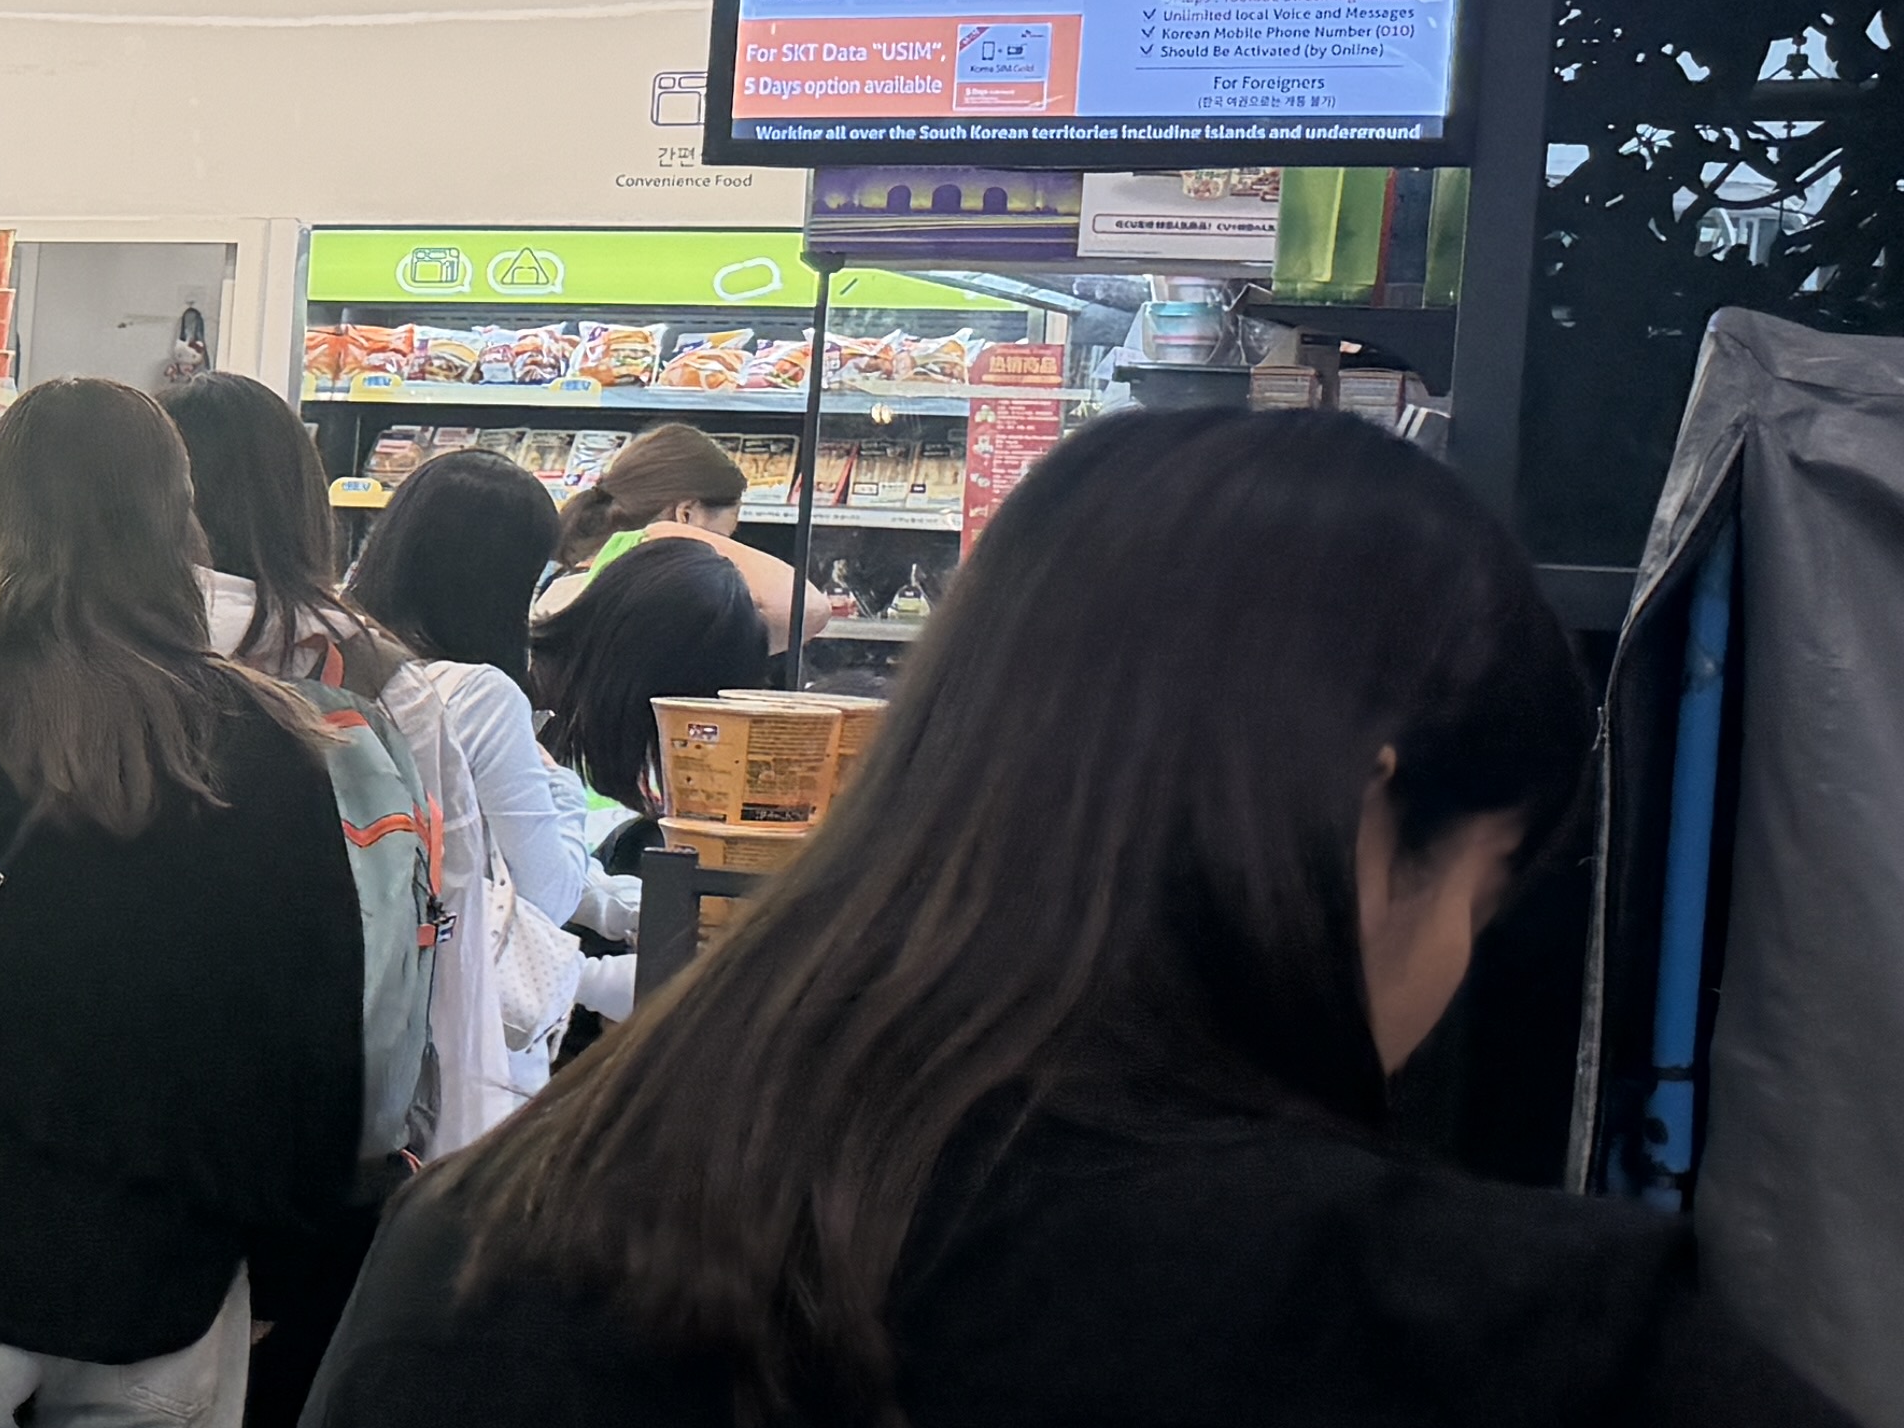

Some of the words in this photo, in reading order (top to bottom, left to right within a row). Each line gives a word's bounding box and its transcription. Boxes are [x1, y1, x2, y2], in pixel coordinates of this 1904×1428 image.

[1163, 9, 1232, 22] Unlimited
[1236, 8, 1269, 20] local
[1274, 8, 1310, 20] Voice
[1315, 8, 1341, 19] and
[1345, 6, 1414, 22] Messages
[1162, 28, 1210, 40] Korean
[1214, 27, 1262, 39] Mobile
[1267, 26, 1310, 39] Phone
[1314, 26, 1371, 38] Number
[1376, 24, 1415, 39] (010)
[747, 44, 775, 62] For
[781, 44, 819, 62] SKT
[823, 43, 867, 61] Data
[1161, 45, 1208, 58] Should
[1234, 44, 1300, 57] Activated
[758, 77, 800, 98] Days
[804, 76, 860, 98] option
[864, 75, 942, 95] available
[1214, 76, 1238, 90] For
[1242, 75, 1325, 93] Foreigners
[919, 125, 966, 140] South
[970, 125, 1028, 140] Korean
[1032, 125, 1118, 140] territories
[1205, 124, 1265, 139] islands
[1269, 124, 1301, 139] and
[1305, 124, 1420, 140] underground
[615, 174, 711, 188] Convenience
[715, 174, 753, 187] Food
